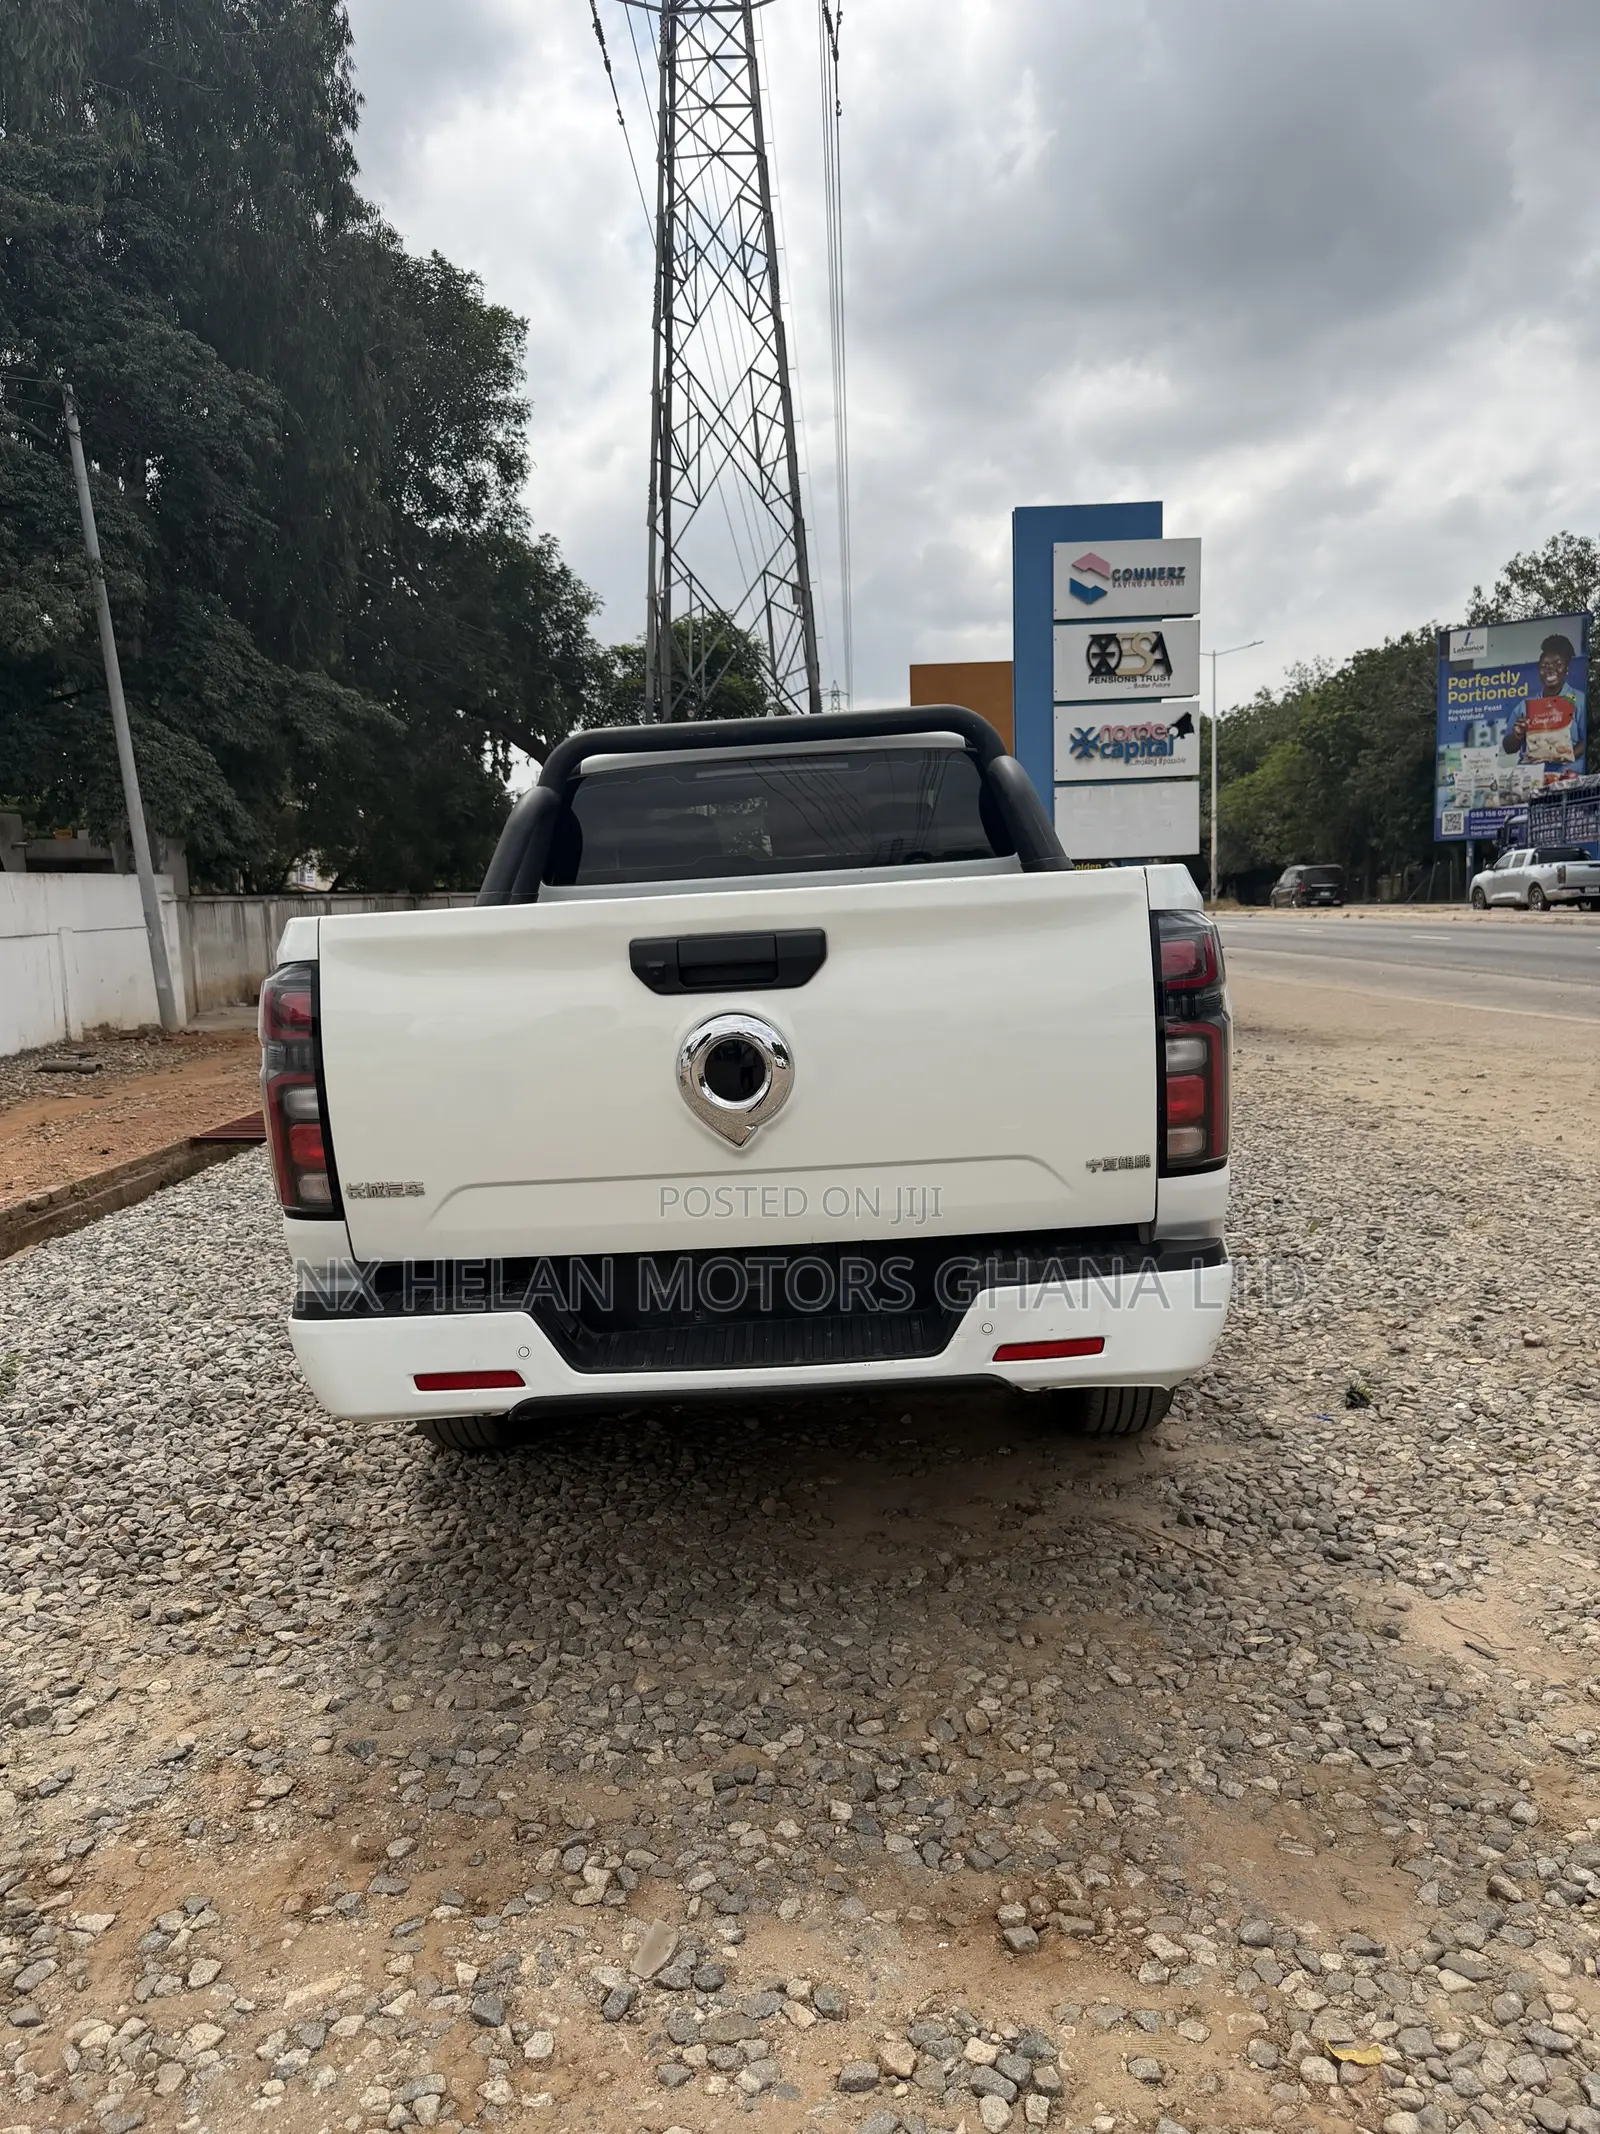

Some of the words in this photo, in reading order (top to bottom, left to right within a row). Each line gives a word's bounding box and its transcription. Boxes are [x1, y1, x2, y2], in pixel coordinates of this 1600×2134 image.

[1111, 566, 1186, 582] COMMERZ
[1158, 579, 1185, 587] LOANS
[1088, 675, 1138, 684] PENSIONS
[1141, 674, 1172, 682] TRUST
[1448, 670, 1521, 691] Perfectly
[1448, 682, 1529, 704] Portioned
[1484, 704, 1502, 712] Feast
[1099, 733, 1174, 764] capital
[346, 1181, 425, 1199] 长城汽车
